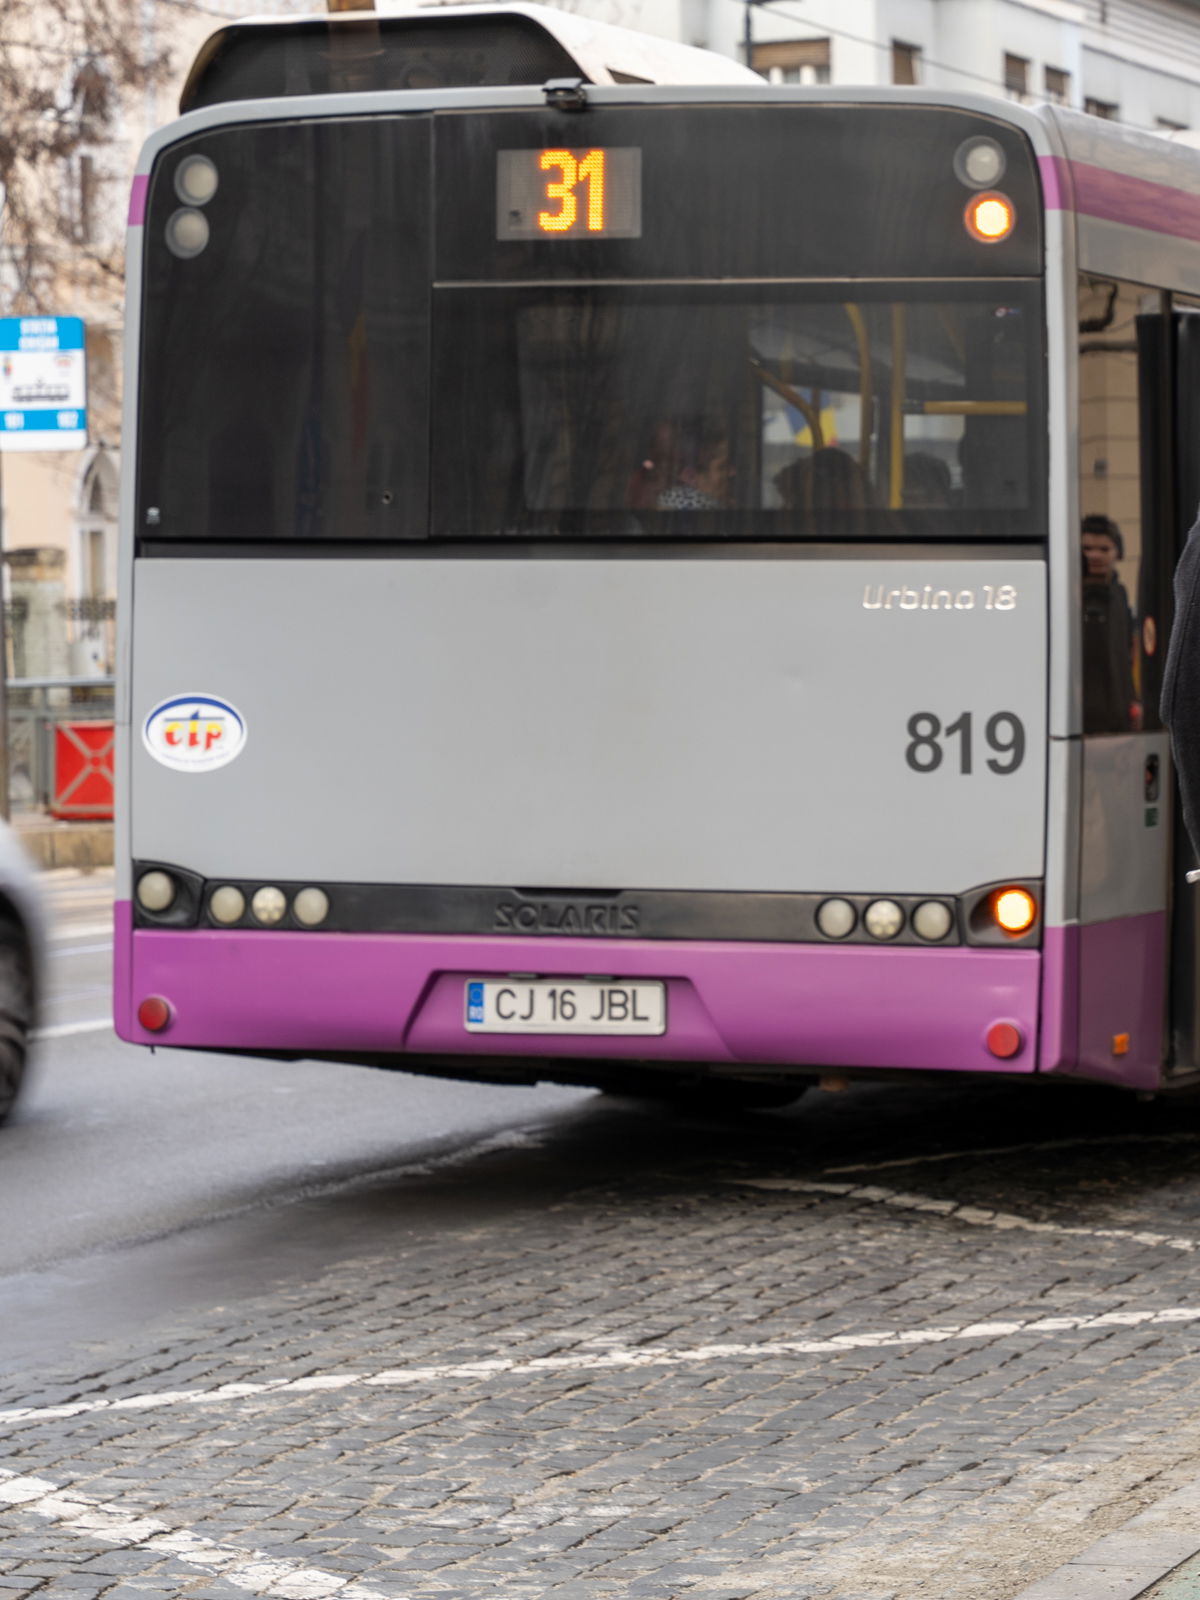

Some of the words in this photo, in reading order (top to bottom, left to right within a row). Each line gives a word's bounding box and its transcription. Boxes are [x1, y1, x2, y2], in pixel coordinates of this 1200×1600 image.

[539, 149, 604, 232] 31
[862, 584, 976, 610] Urbino
[983, 584, 1018, 611] 18
[905, 710, 1026, 776] 819
[493, 902, 640, 935] SOLARIS
[496, 988, 535, 1021] CJ
[548, 988, 577, 1022] 16
[590, 988, 649, 1022] JBL
